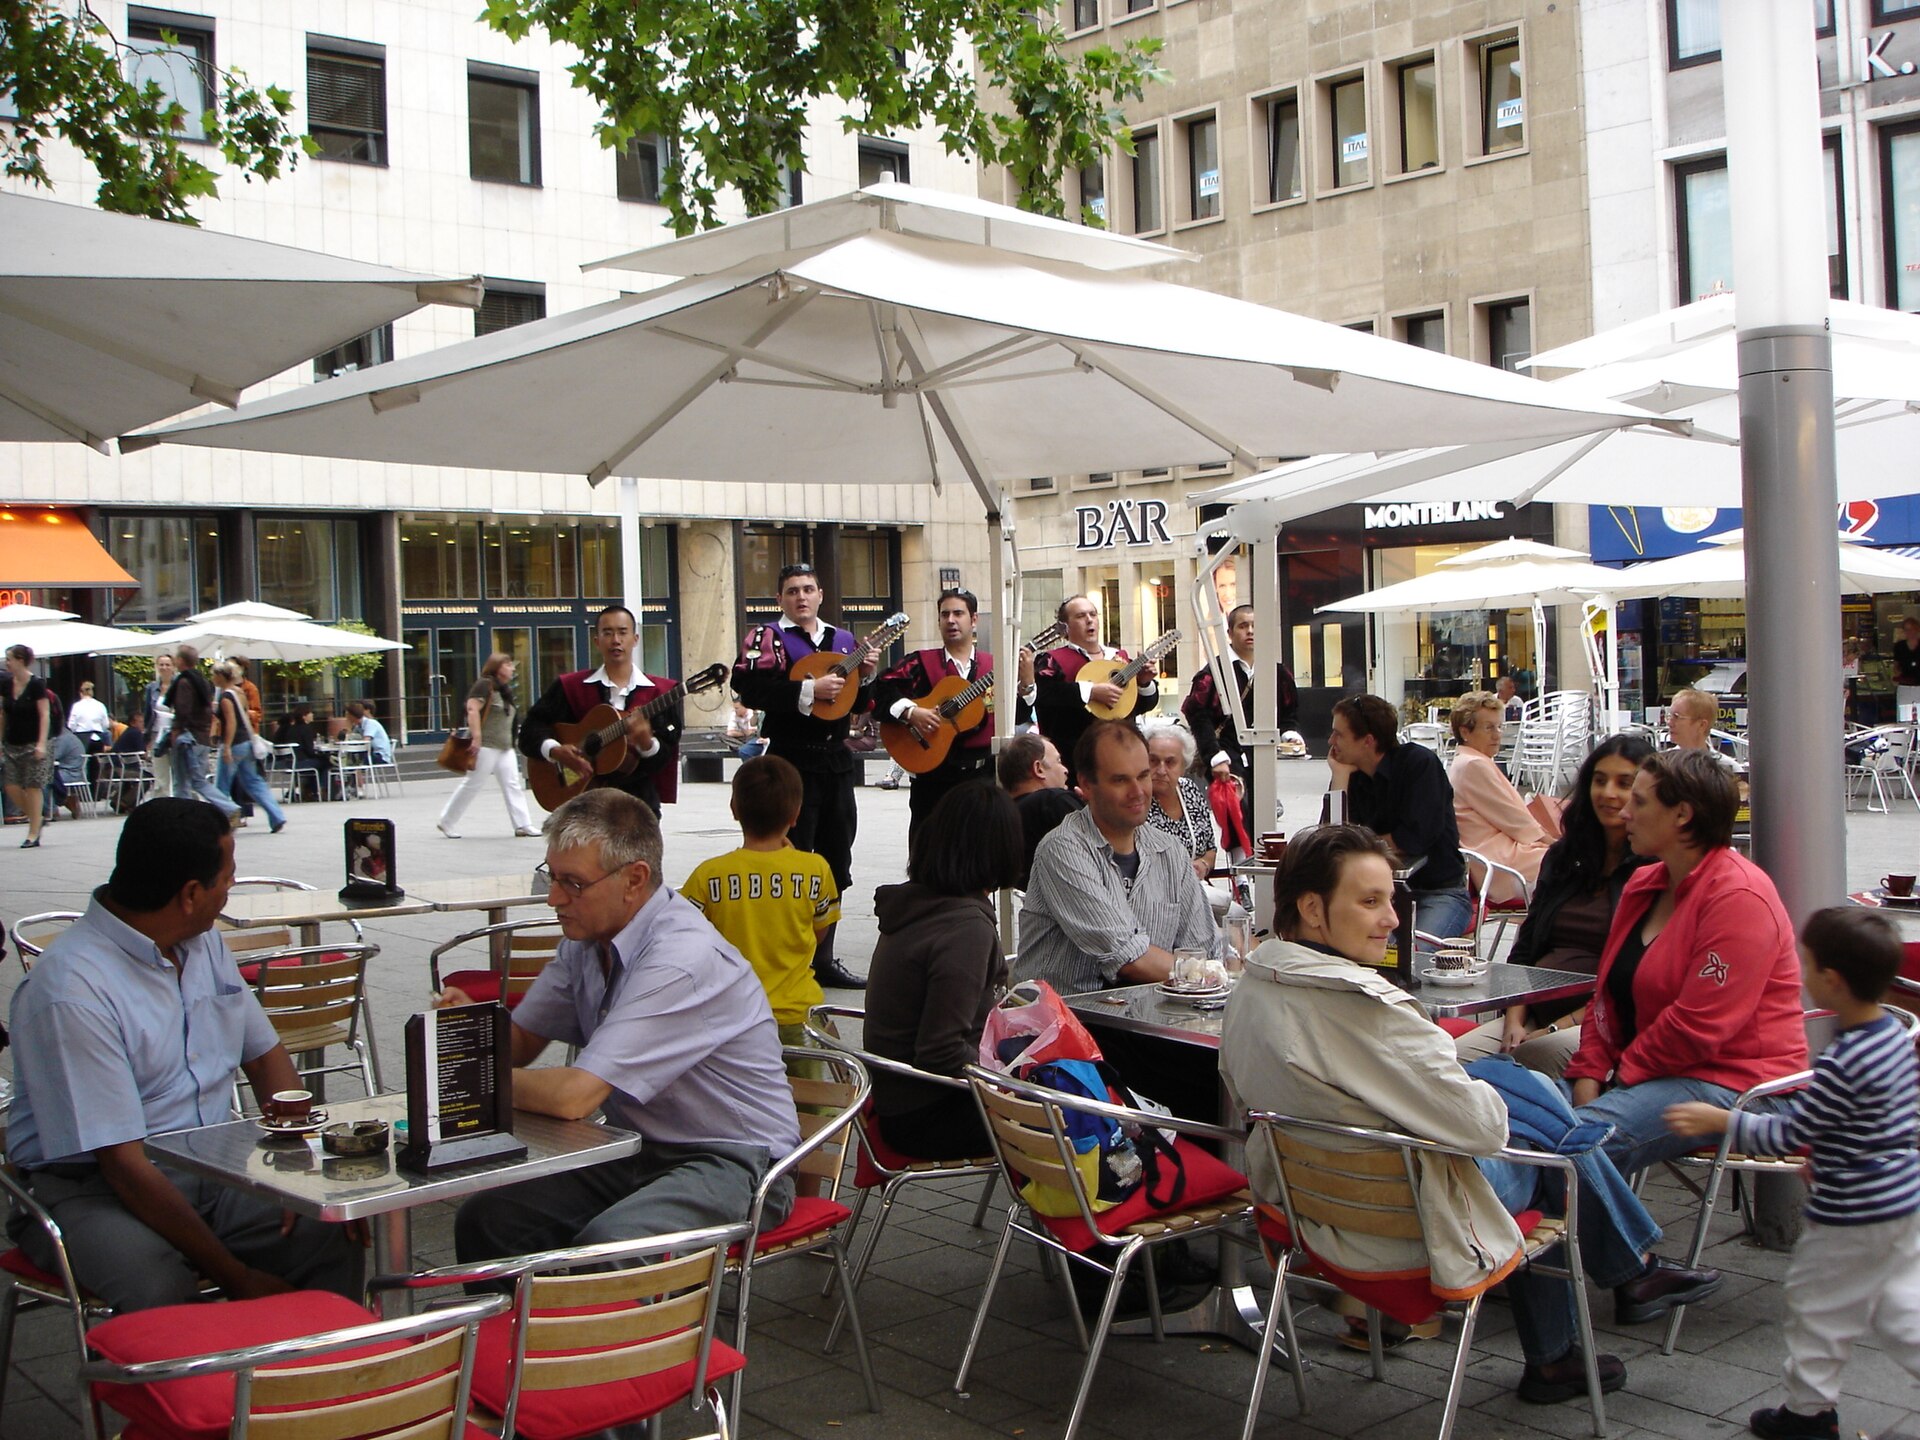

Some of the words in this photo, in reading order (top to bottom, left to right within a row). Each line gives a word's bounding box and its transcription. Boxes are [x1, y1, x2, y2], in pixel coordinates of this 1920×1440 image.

[1348, 140, 1367, 152] ITAL
[1364, 500, 1505, 530] MONTBLANC
[1075, 499, 1173, 551] BÄR
[443, 605, 479, 614] RUNDFUNK
[493, 605, 527, 613] FUNKHAUS
[528, 604, 573, 613] WALLRAFPLATZ
[858, 604, 884, 612] RUNDFUNK
[708, 872, 822, 903] UBBSTE
